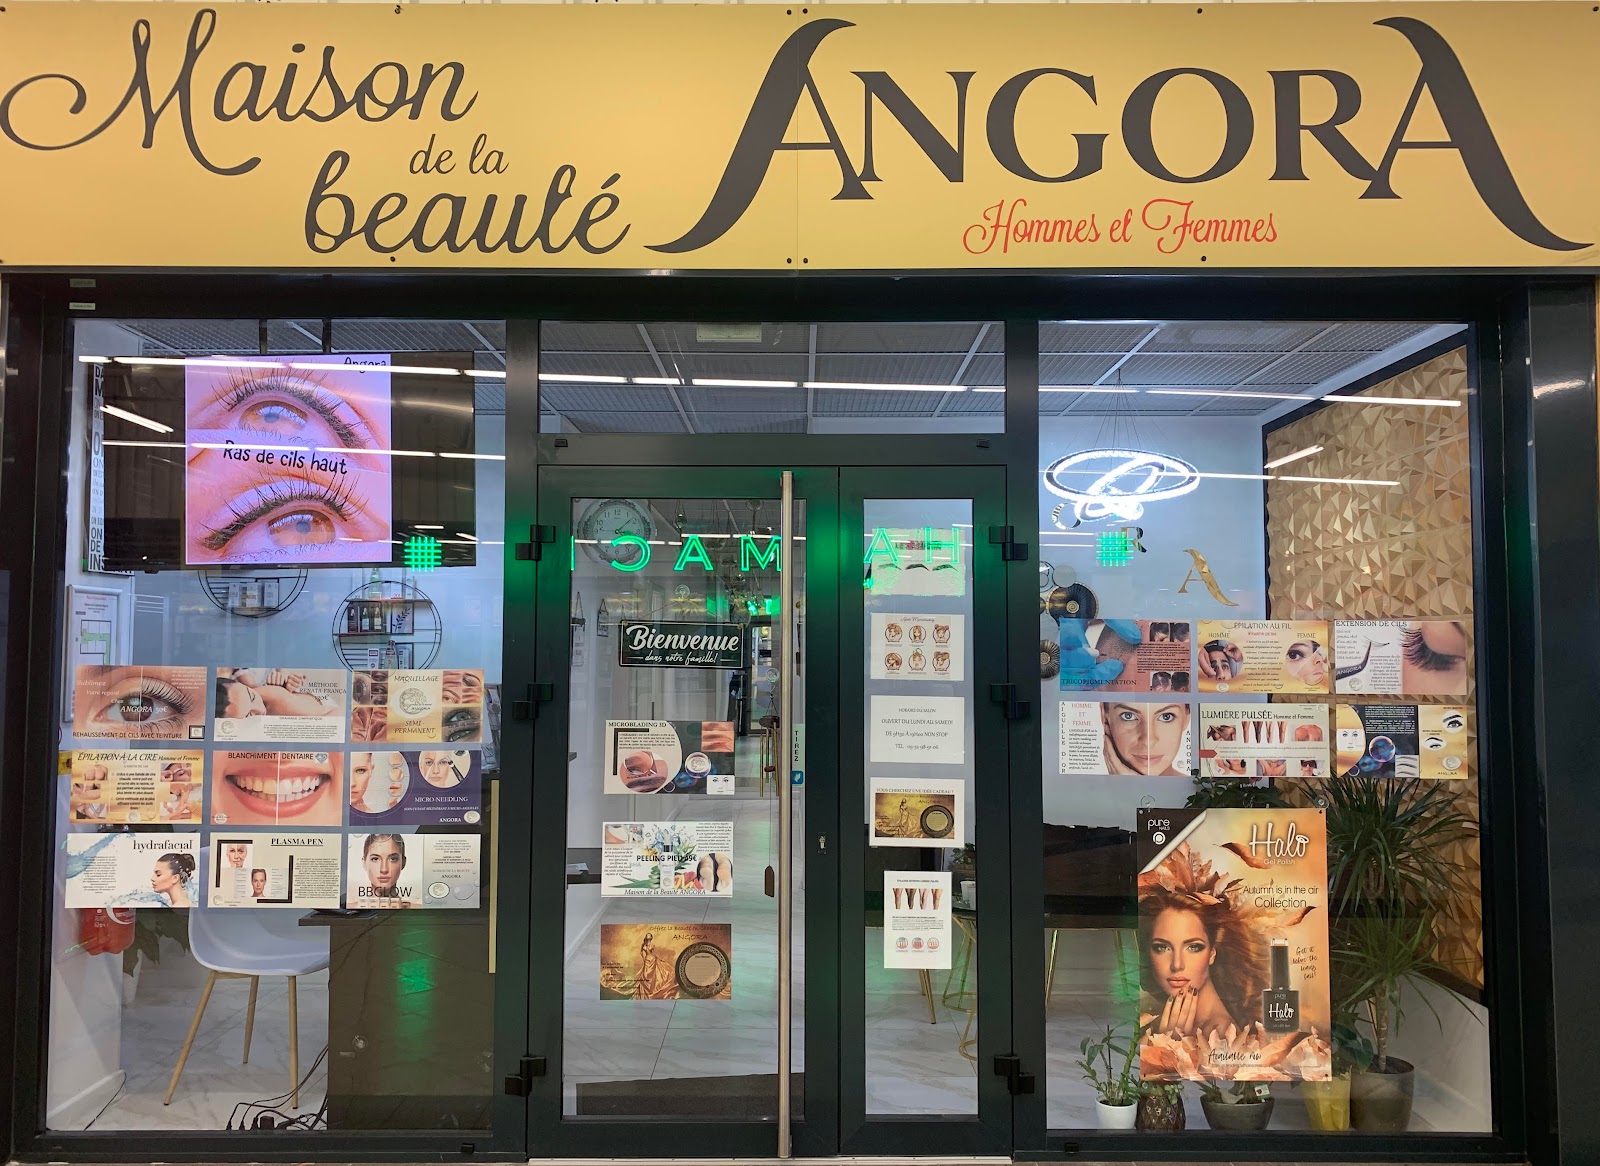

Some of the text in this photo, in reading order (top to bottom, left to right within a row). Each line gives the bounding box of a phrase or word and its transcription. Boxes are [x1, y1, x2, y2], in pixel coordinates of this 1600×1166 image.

[1, 9, 479, 175] Maison
[644, 16, 1594, 252] ANGORA
[409, 133, 509, 174] de la
[304, 150, 631, 254] beauté
[963, 199, 1278, 254] Hommes et Femmes
[223, 440, 348, 475] Ras de cils haut
[626, 625, 739, 651] Bienvenue
[645, 650, 662, 662] dans
[1201, 710, 1239, 719] LUMIÈRE
[1241, 710, 1272, 719] PULSÉE
[78, 752, 118, 761] ÉPILATION
[1148, 819, 1170, 830] pure
[133, 840, 194, 852] hydrafacial
[1249, 822, 1309, 857] Halo
[1243, 886, 1273, 895] Autumn
[1276, 886, 1283, 894] is
[1285, 886, 1292, 895] in
[1293, 886, 1306, 895] the
[1254, 896, 1307, 908] Collection
[1296, 947, 1308, 956] Get
[1268, 1003, 1294, 1019] Halo
